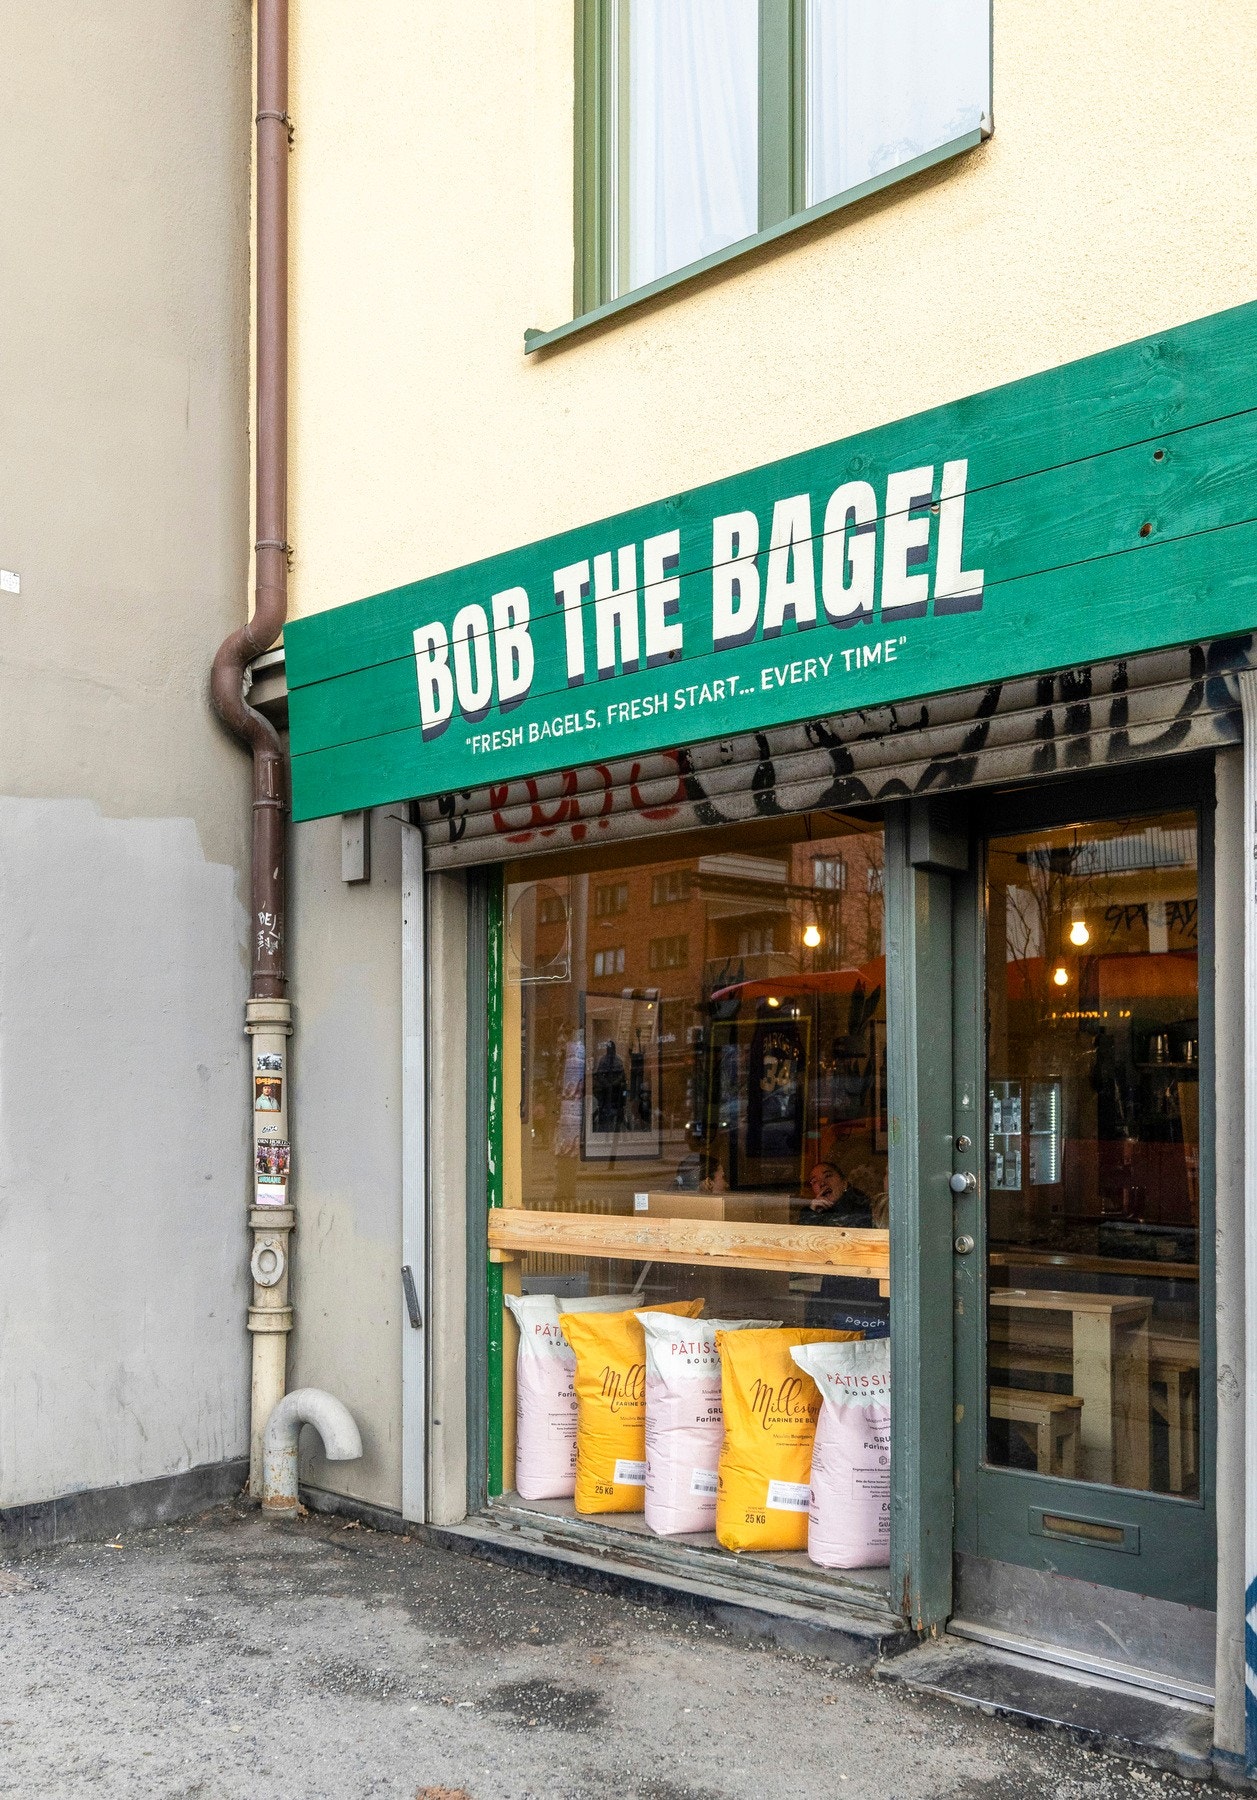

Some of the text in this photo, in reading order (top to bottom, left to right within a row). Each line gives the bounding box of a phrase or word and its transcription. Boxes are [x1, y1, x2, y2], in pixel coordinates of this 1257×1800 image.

[412, 458, 985, 742] BOB THE BAGEL
[465, 716, 524, 755] "FRESH
[607, 692, 669, 725] FRESH
[673, 675, 755, 710] START...
[760, 653, 834, 690] EVERY
[840, 635, 907, 672] TIME"
[863, 1442, 889, 1451] Farine
[595, 1485, 614, 1495] 25 KG
[745, 1513, 766, 1524] 25 KG
